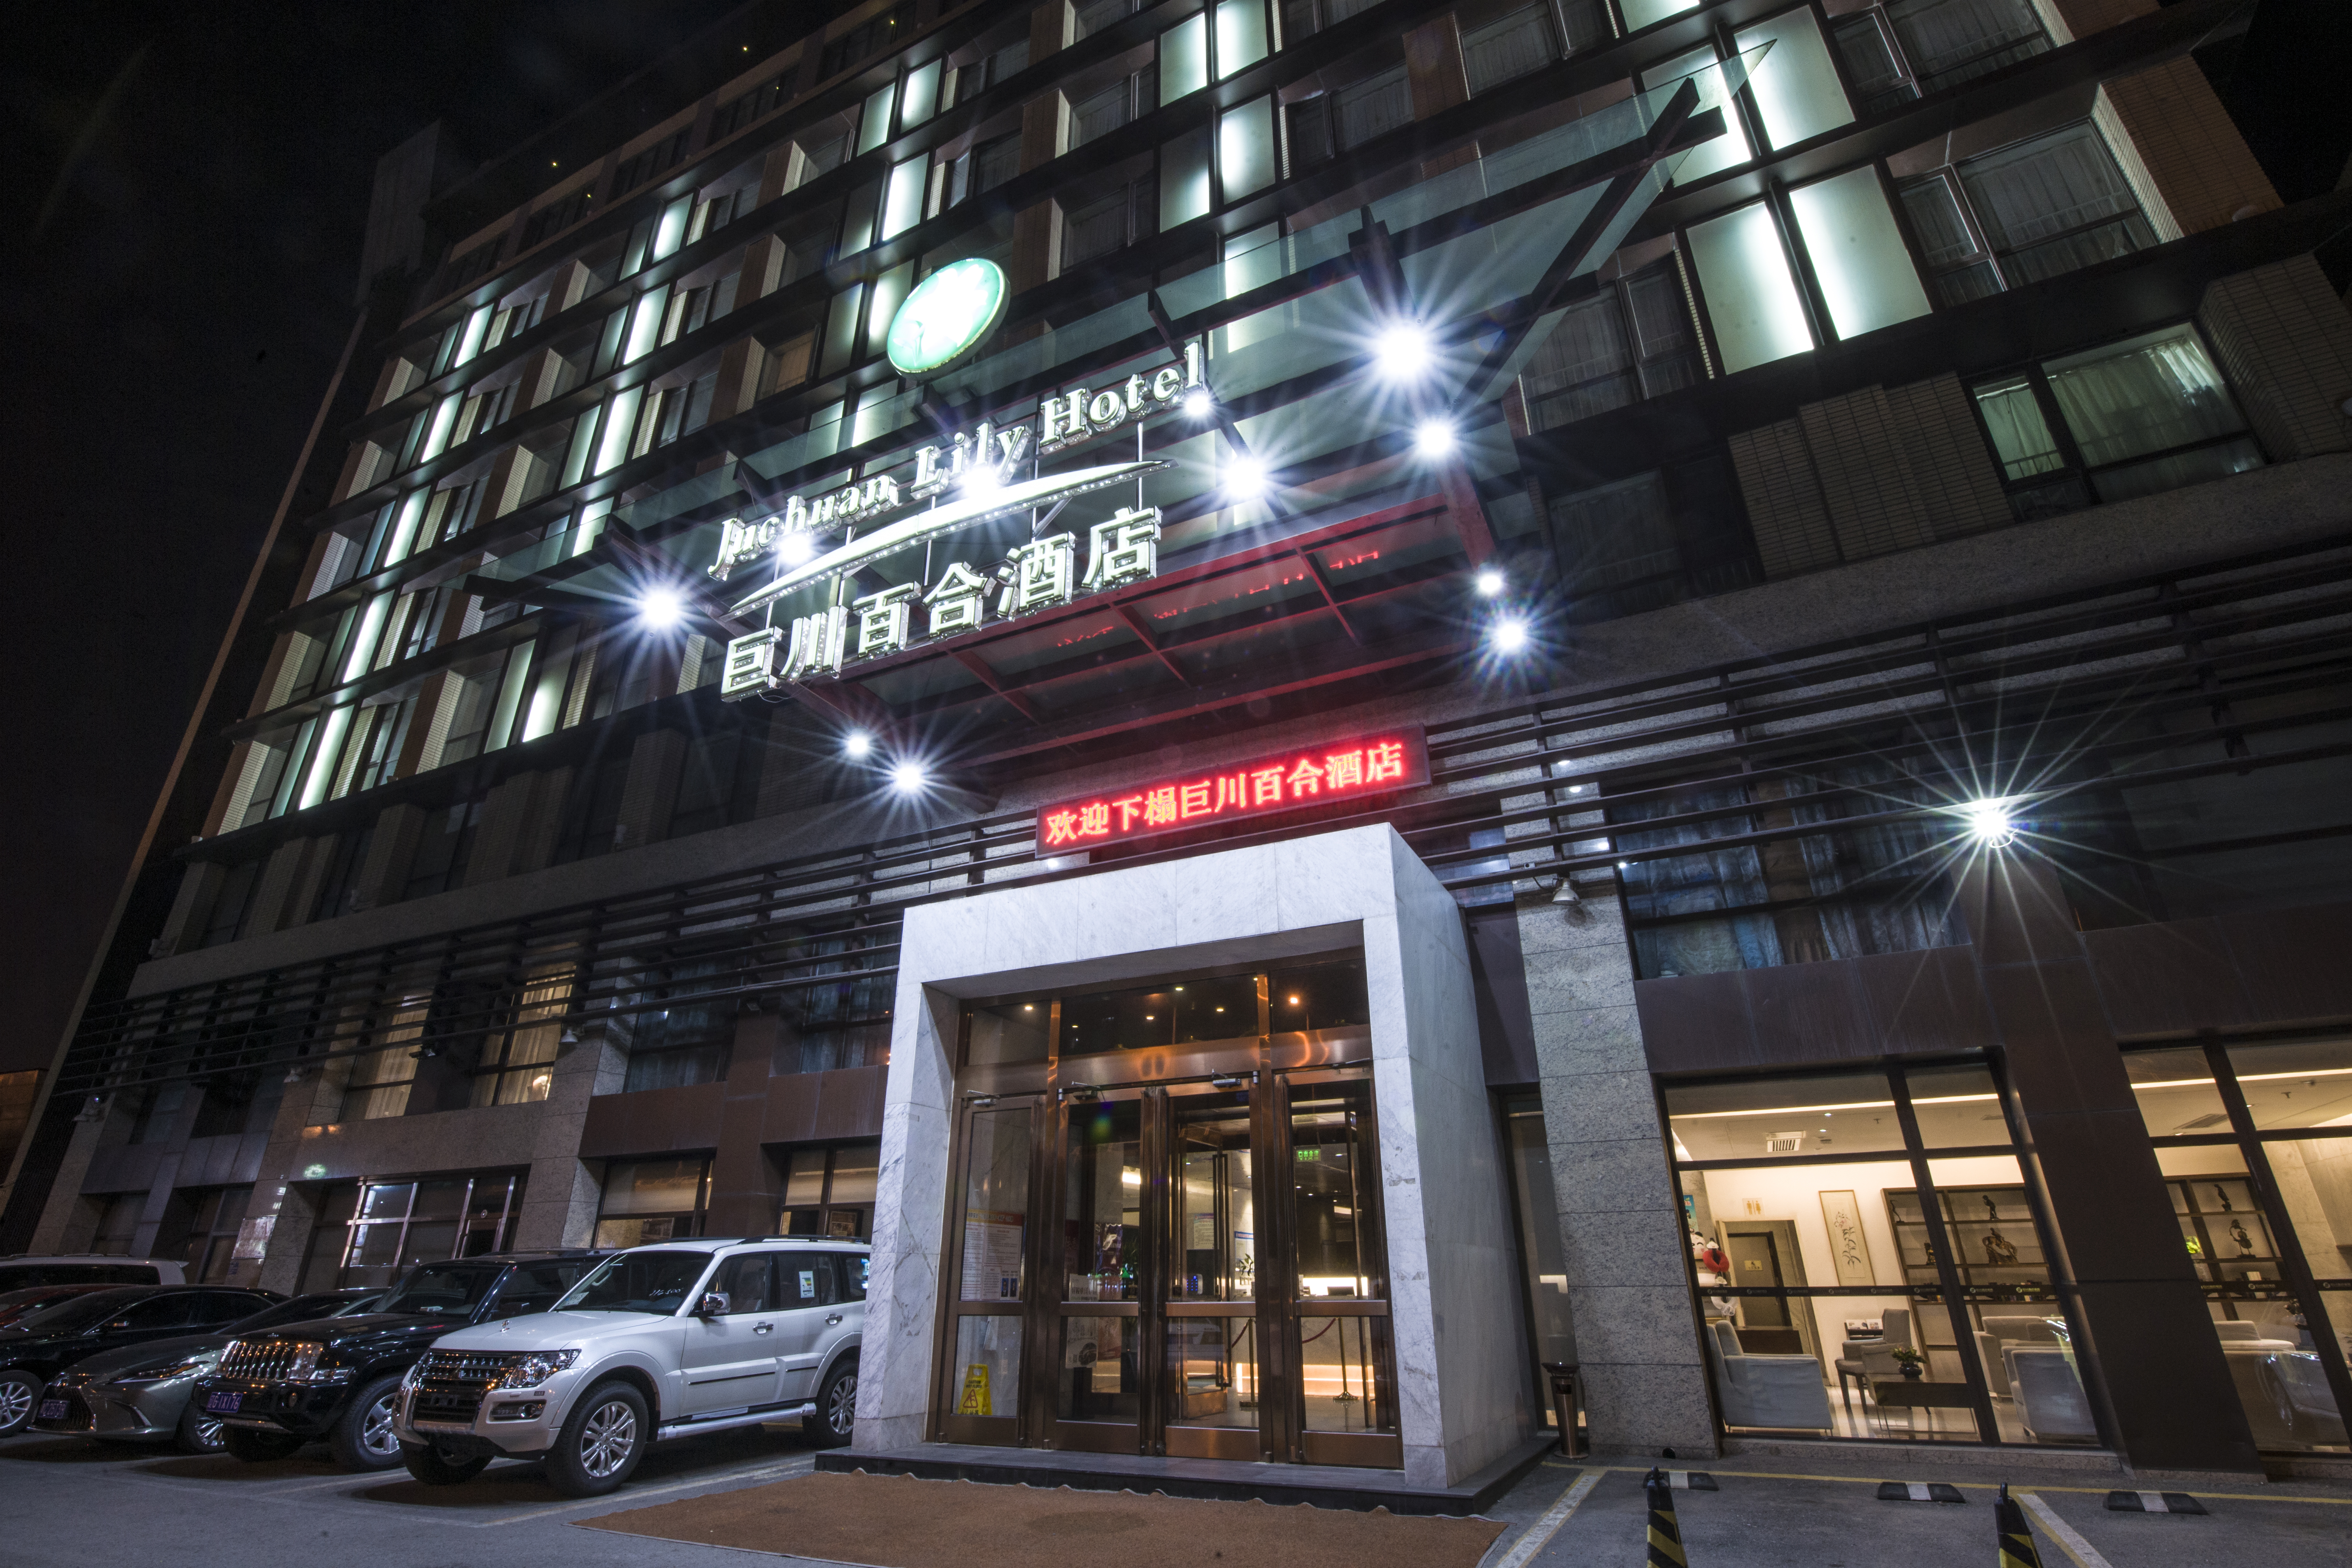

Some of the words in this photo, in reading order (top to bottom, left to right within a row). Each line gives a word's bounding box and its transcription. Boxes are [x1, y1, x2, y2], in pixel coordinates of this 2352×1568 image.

[708, 475, 898, 581] Juchuan
[910, 422, 1032, 499] Lily
[1039, 341, 1206, 453] Hotel
[721, 506, 1162, 702] 巨川百合酒店
[1046, 744, 1402, 844] 欢迎下榻巨川百合酒店
